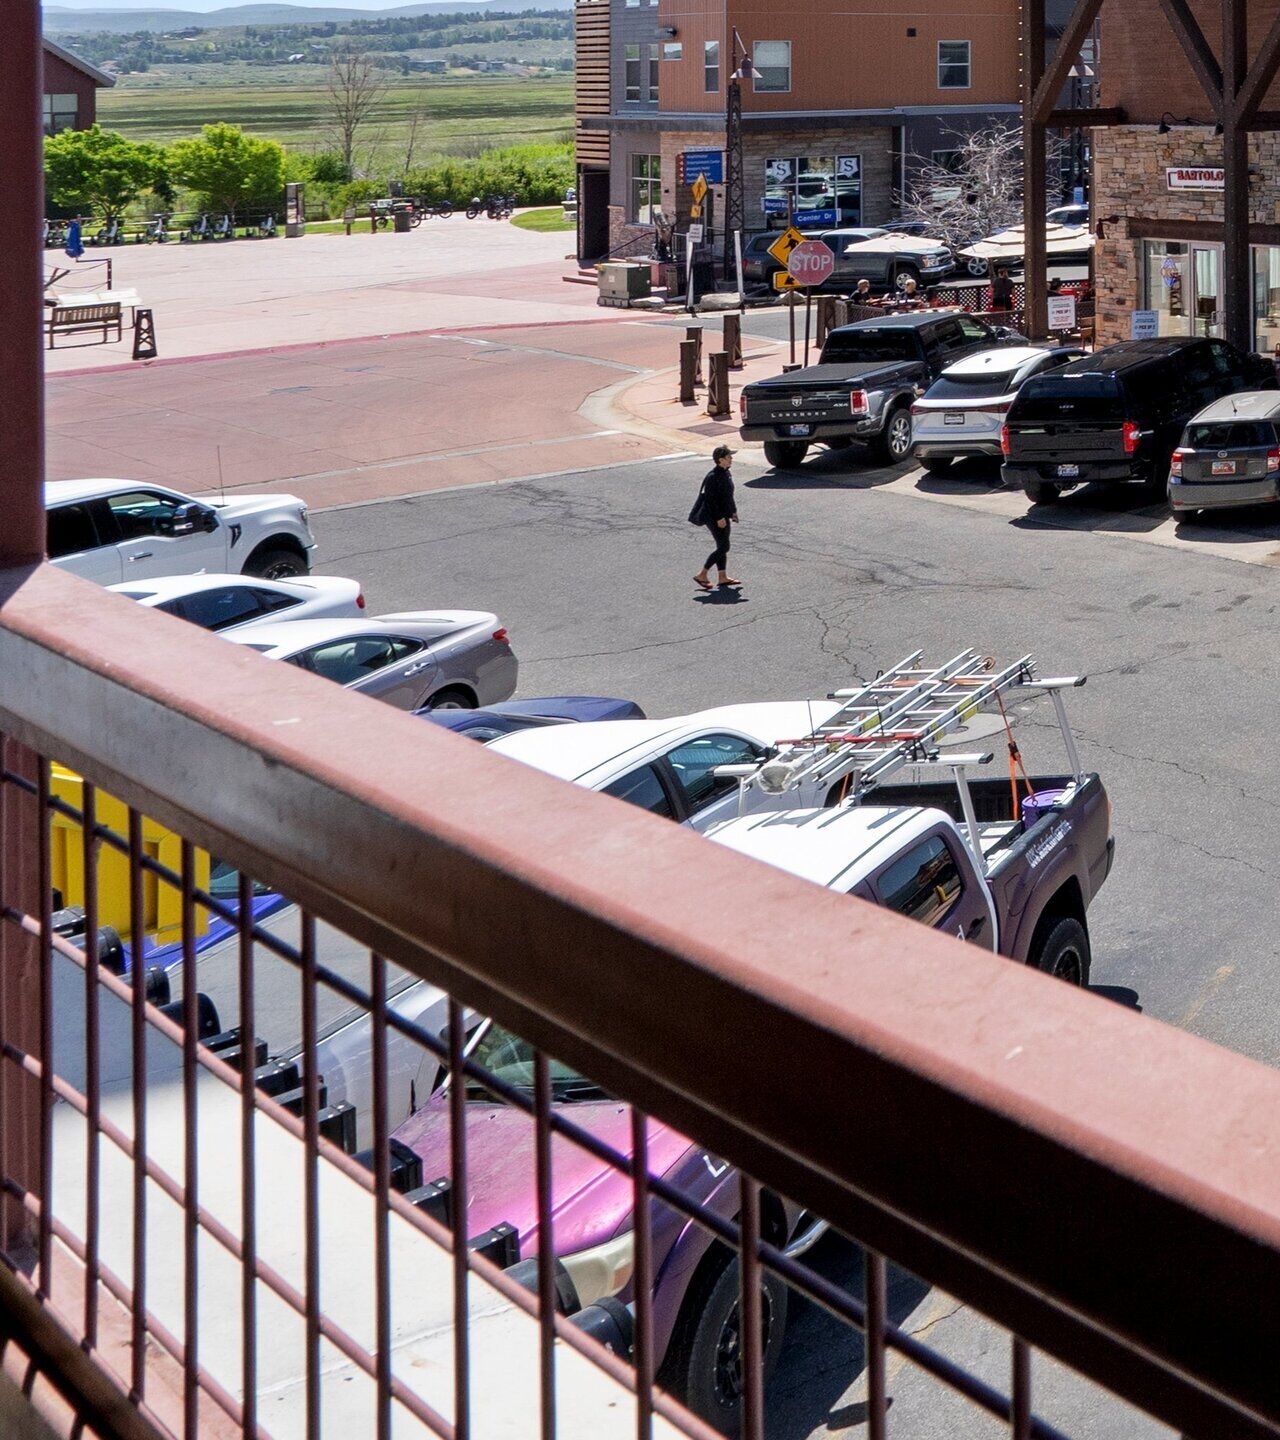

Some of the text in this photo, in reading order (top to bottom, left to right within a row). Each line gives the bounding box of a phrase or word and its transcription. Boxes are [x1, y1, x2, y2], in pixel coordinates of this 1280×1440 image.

[776, 162, 787, 176] S
[844, 159, 854, 172] S
[797, 214, 821, 222] Center
[791, 255, 831, 271] STOP
